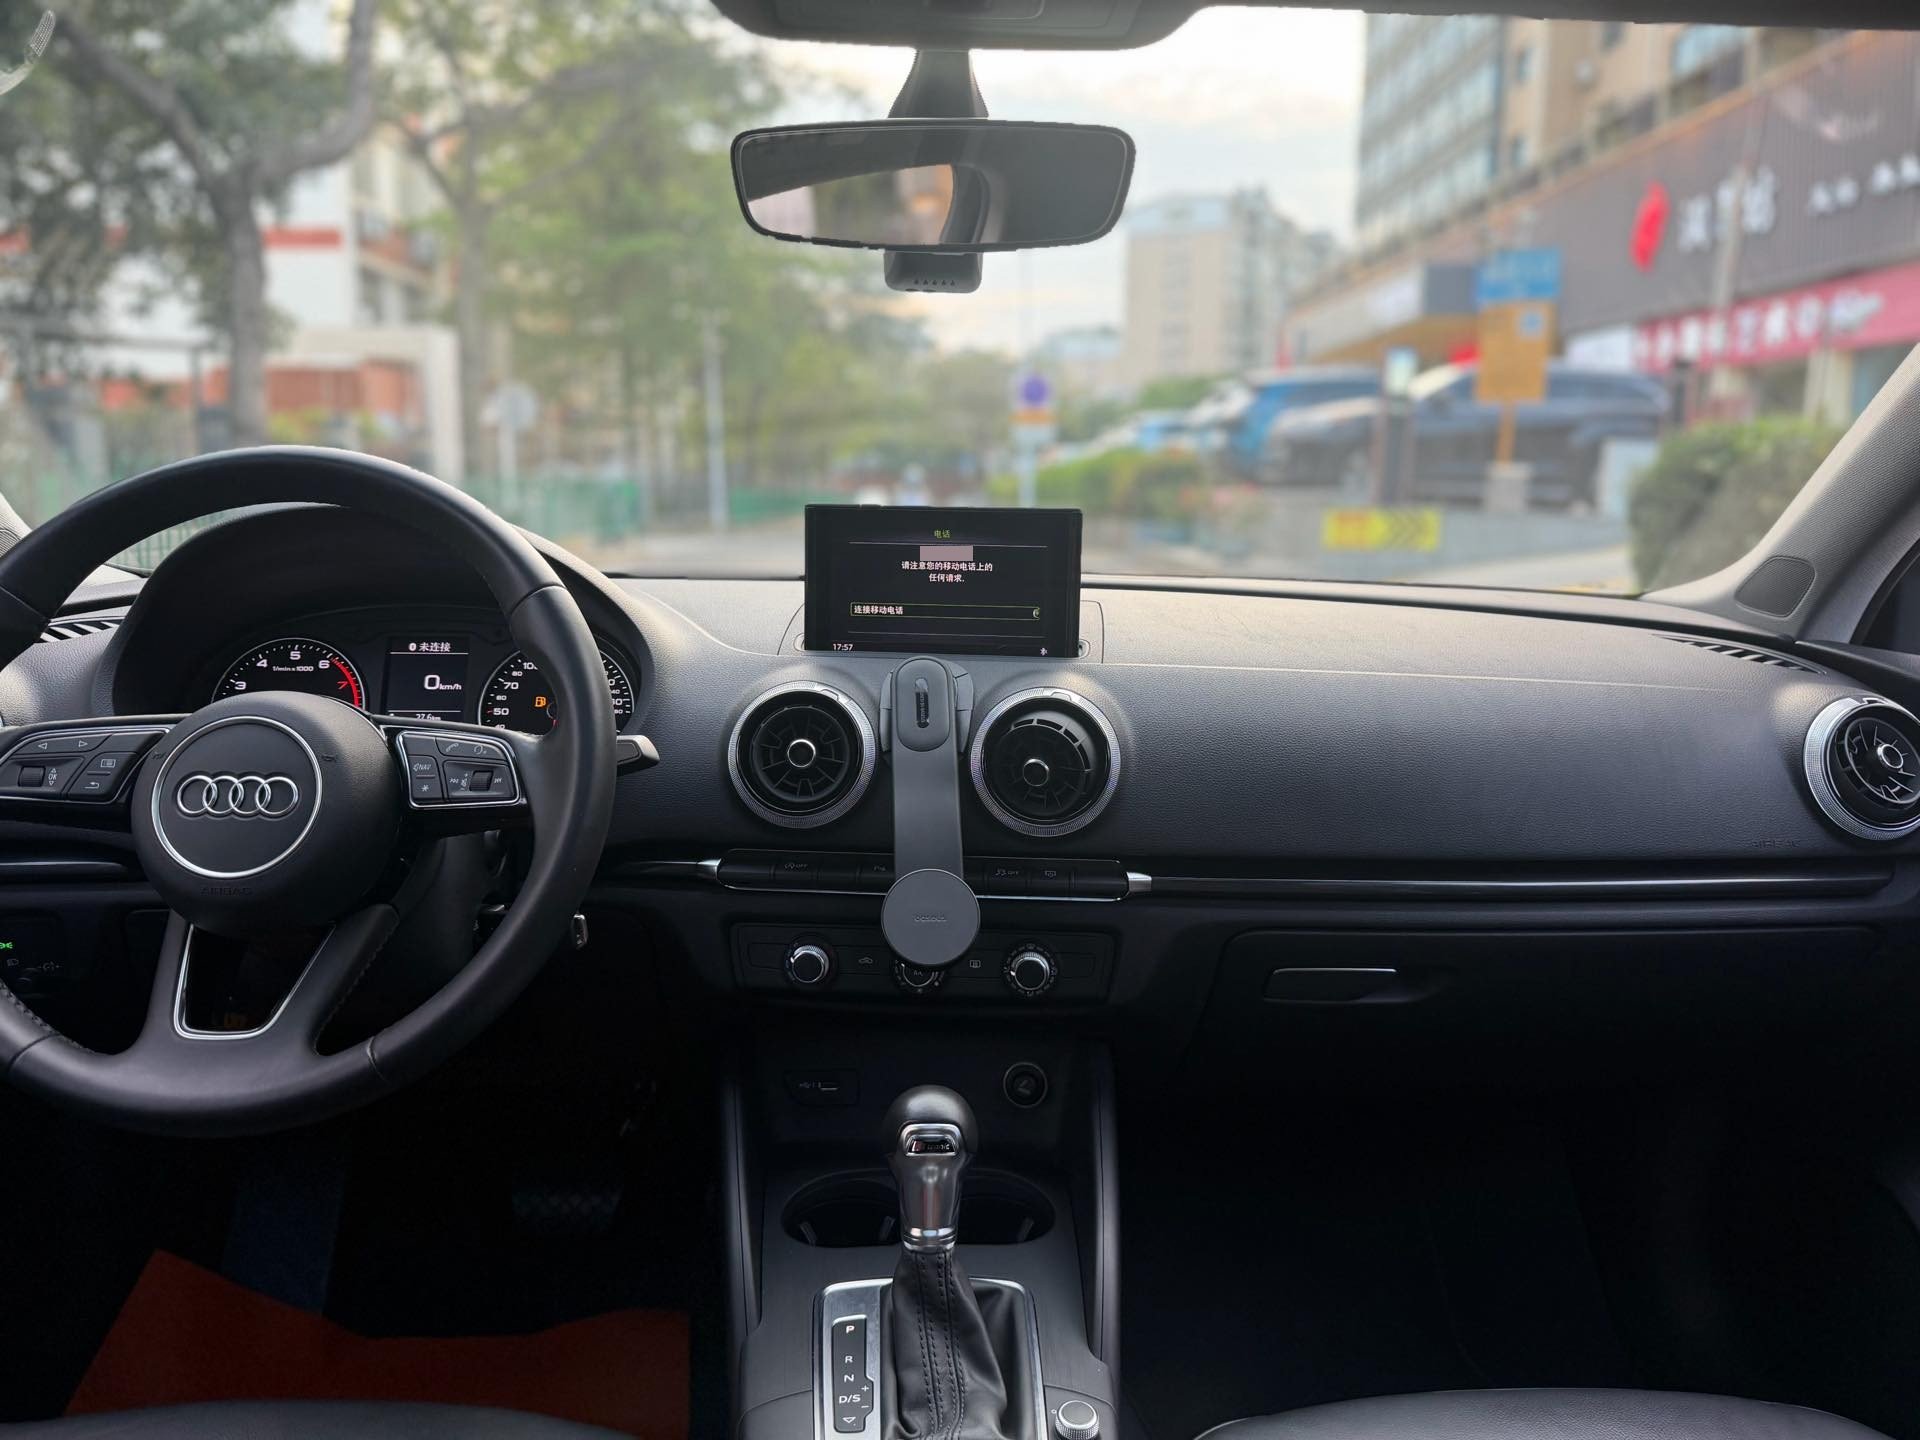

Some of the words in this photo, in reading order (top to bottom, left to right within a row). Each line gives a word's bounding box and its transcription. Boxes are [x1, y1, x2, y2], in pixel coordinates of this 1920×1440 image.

[934, 529, 951, 539] 电话
[901, 560, 993, 572] 请注意您的移动电话上的
[853, 604, 904, 615] 连接移动电话
[419, 641, 451, 652] 未连接
[832, 643, 854, 651] 17:57
[289, 651, 301, 660] 5
[256, 658, 268, 668] 4
[318, 659, 330, 669] 6
[522, 661, 538, 670] 10
[234, 681, 246, 690] 3
[336, 681, 348, 690] 7
[503, 681, 519, 690] 70
[493, 707, 510, 716] 50
[845, 1325, 855, 1334] P
[844, 1355, 853, 1364] R
[843, 1374, 855, 1383] N
[838, 1394, 861, 1404] D/S
